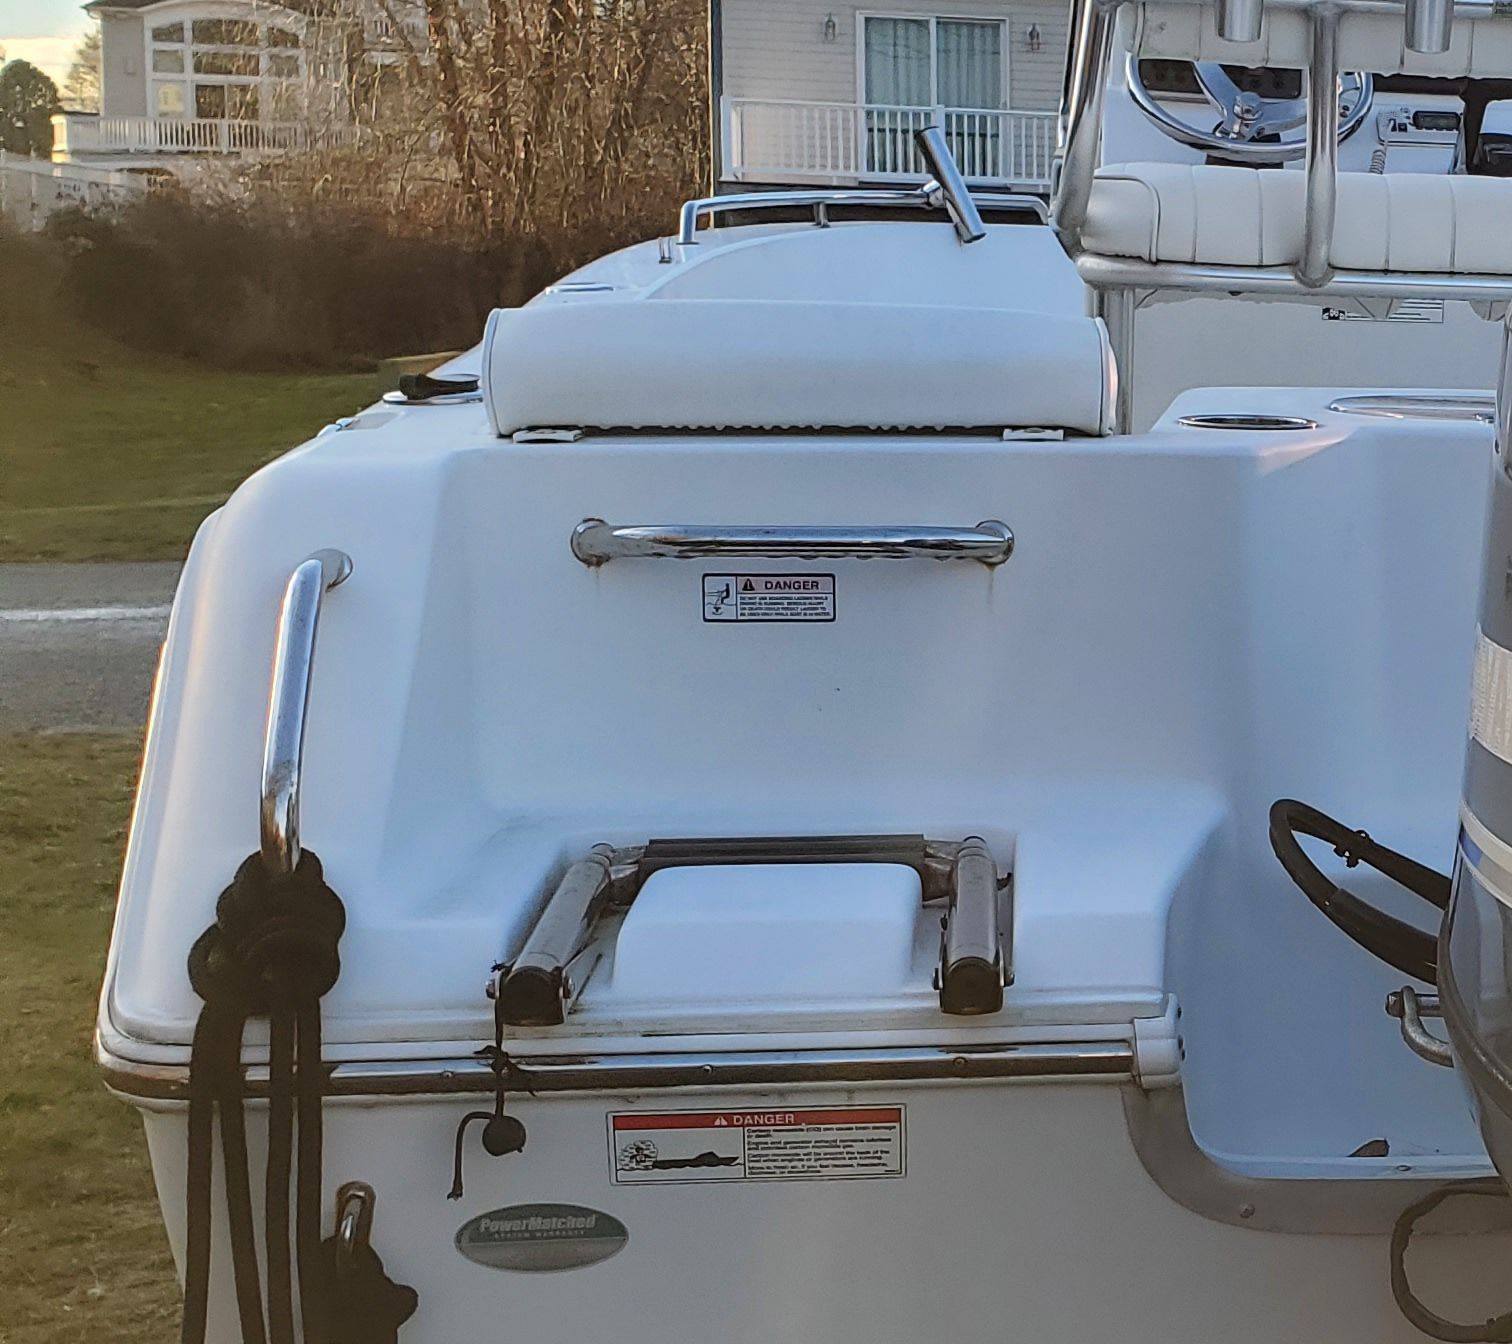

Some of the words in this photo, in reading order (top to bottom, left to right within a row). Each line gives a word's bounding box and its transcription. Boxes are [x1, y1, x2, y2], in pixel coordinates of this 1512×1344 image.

[764, 580, 820, 591] DANGER
[733, 1113, 795, 1126] DANGER
[479, 1214, 597, 1233] PowerMatched
